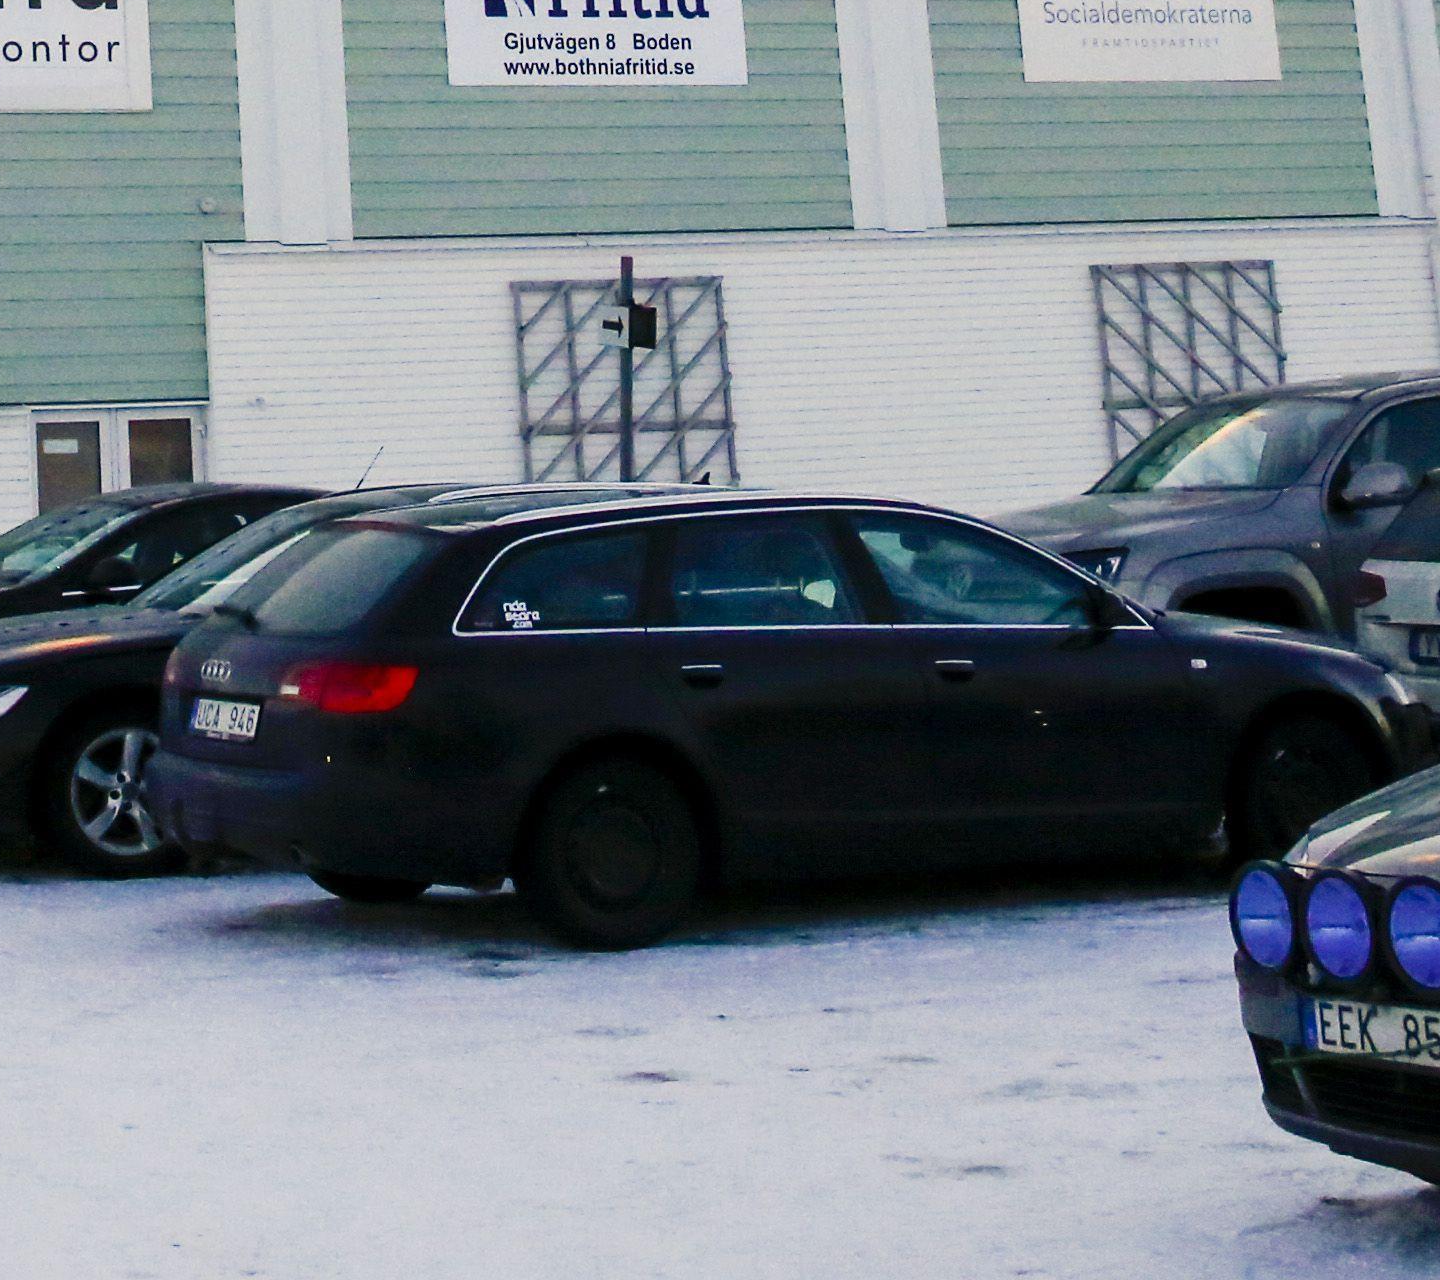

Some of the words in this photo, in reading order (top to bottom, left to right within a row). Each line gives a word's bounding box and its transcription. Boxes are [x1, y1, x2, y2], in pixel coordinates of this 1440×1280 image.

[1043, 1, 1252, 24] Socialdemokraterna
[504, 32, 600, 54] Gjutvägen
[606, 33, 616, 50] 8
[633, 33, 692, 50] Boden
[504, 58, 695, 76] www.bothniafritid.se
[197, 703, 220, 728] UCA
[228, 705, 256, 733] 946
[1319, 1002, 1378, 1054] EEK
